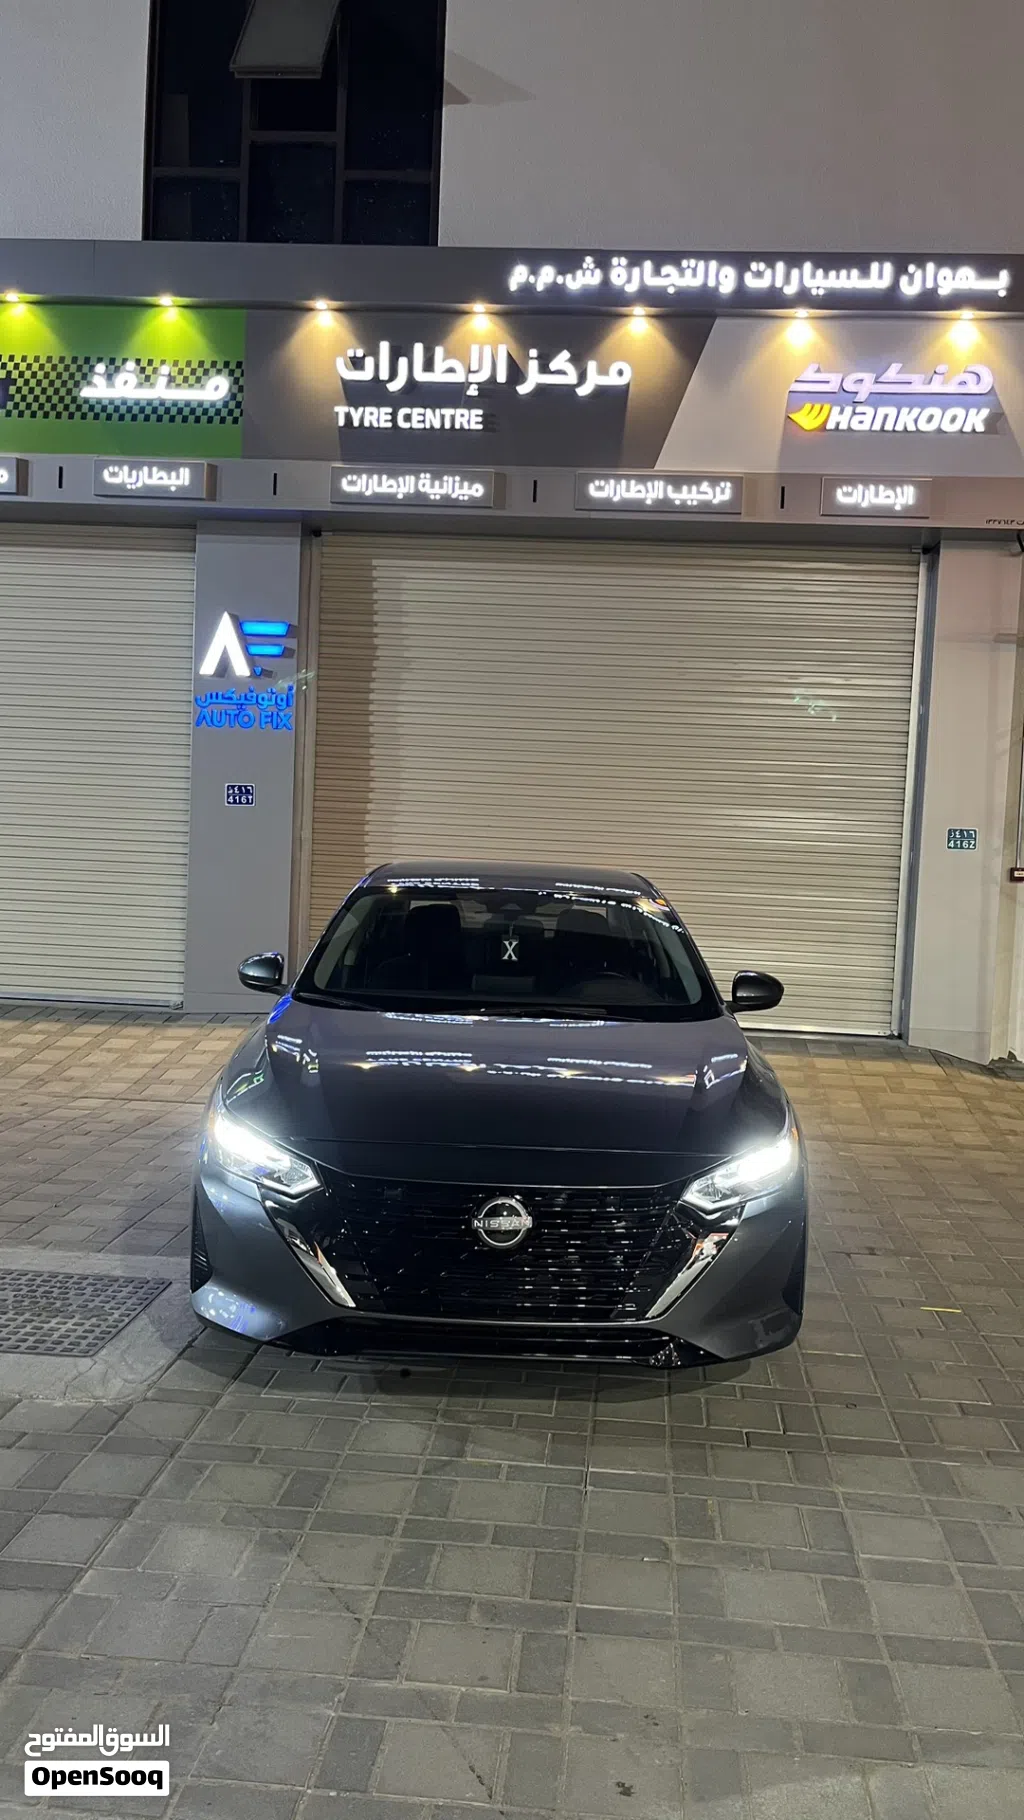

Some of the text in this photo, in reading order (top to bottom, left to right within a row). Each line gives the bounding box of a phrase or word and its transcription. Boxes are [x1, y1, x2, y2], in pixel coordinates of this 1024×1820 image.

[610, 256, 736, 295] والتجارة
[744, 259, 893, 296] للسيارات
[900, 256, 1010, 298] بهوان
[80, 361, 230, 401] منفذ
[336, 341, 632, 397] مركز الإطارات
[788, 362, 994, 403] هنكوك
[334, 406, 484, 431] TYRE CENTRE
[103, 465, 190, 491] البطاريات
[341, 473, 484, 501] ميزانية الإطارات
[588, 479, 731, 505] تركيب الإطارات
[835, 484, 915, 510] الإطارات
[195, 684, 294, 711] أوتوفيكس
[195, 709, 293, 731] AUTO FIX
[948, 840, 975, 849] 416Z
[474, 1219, 530, 1229] NISSAN
